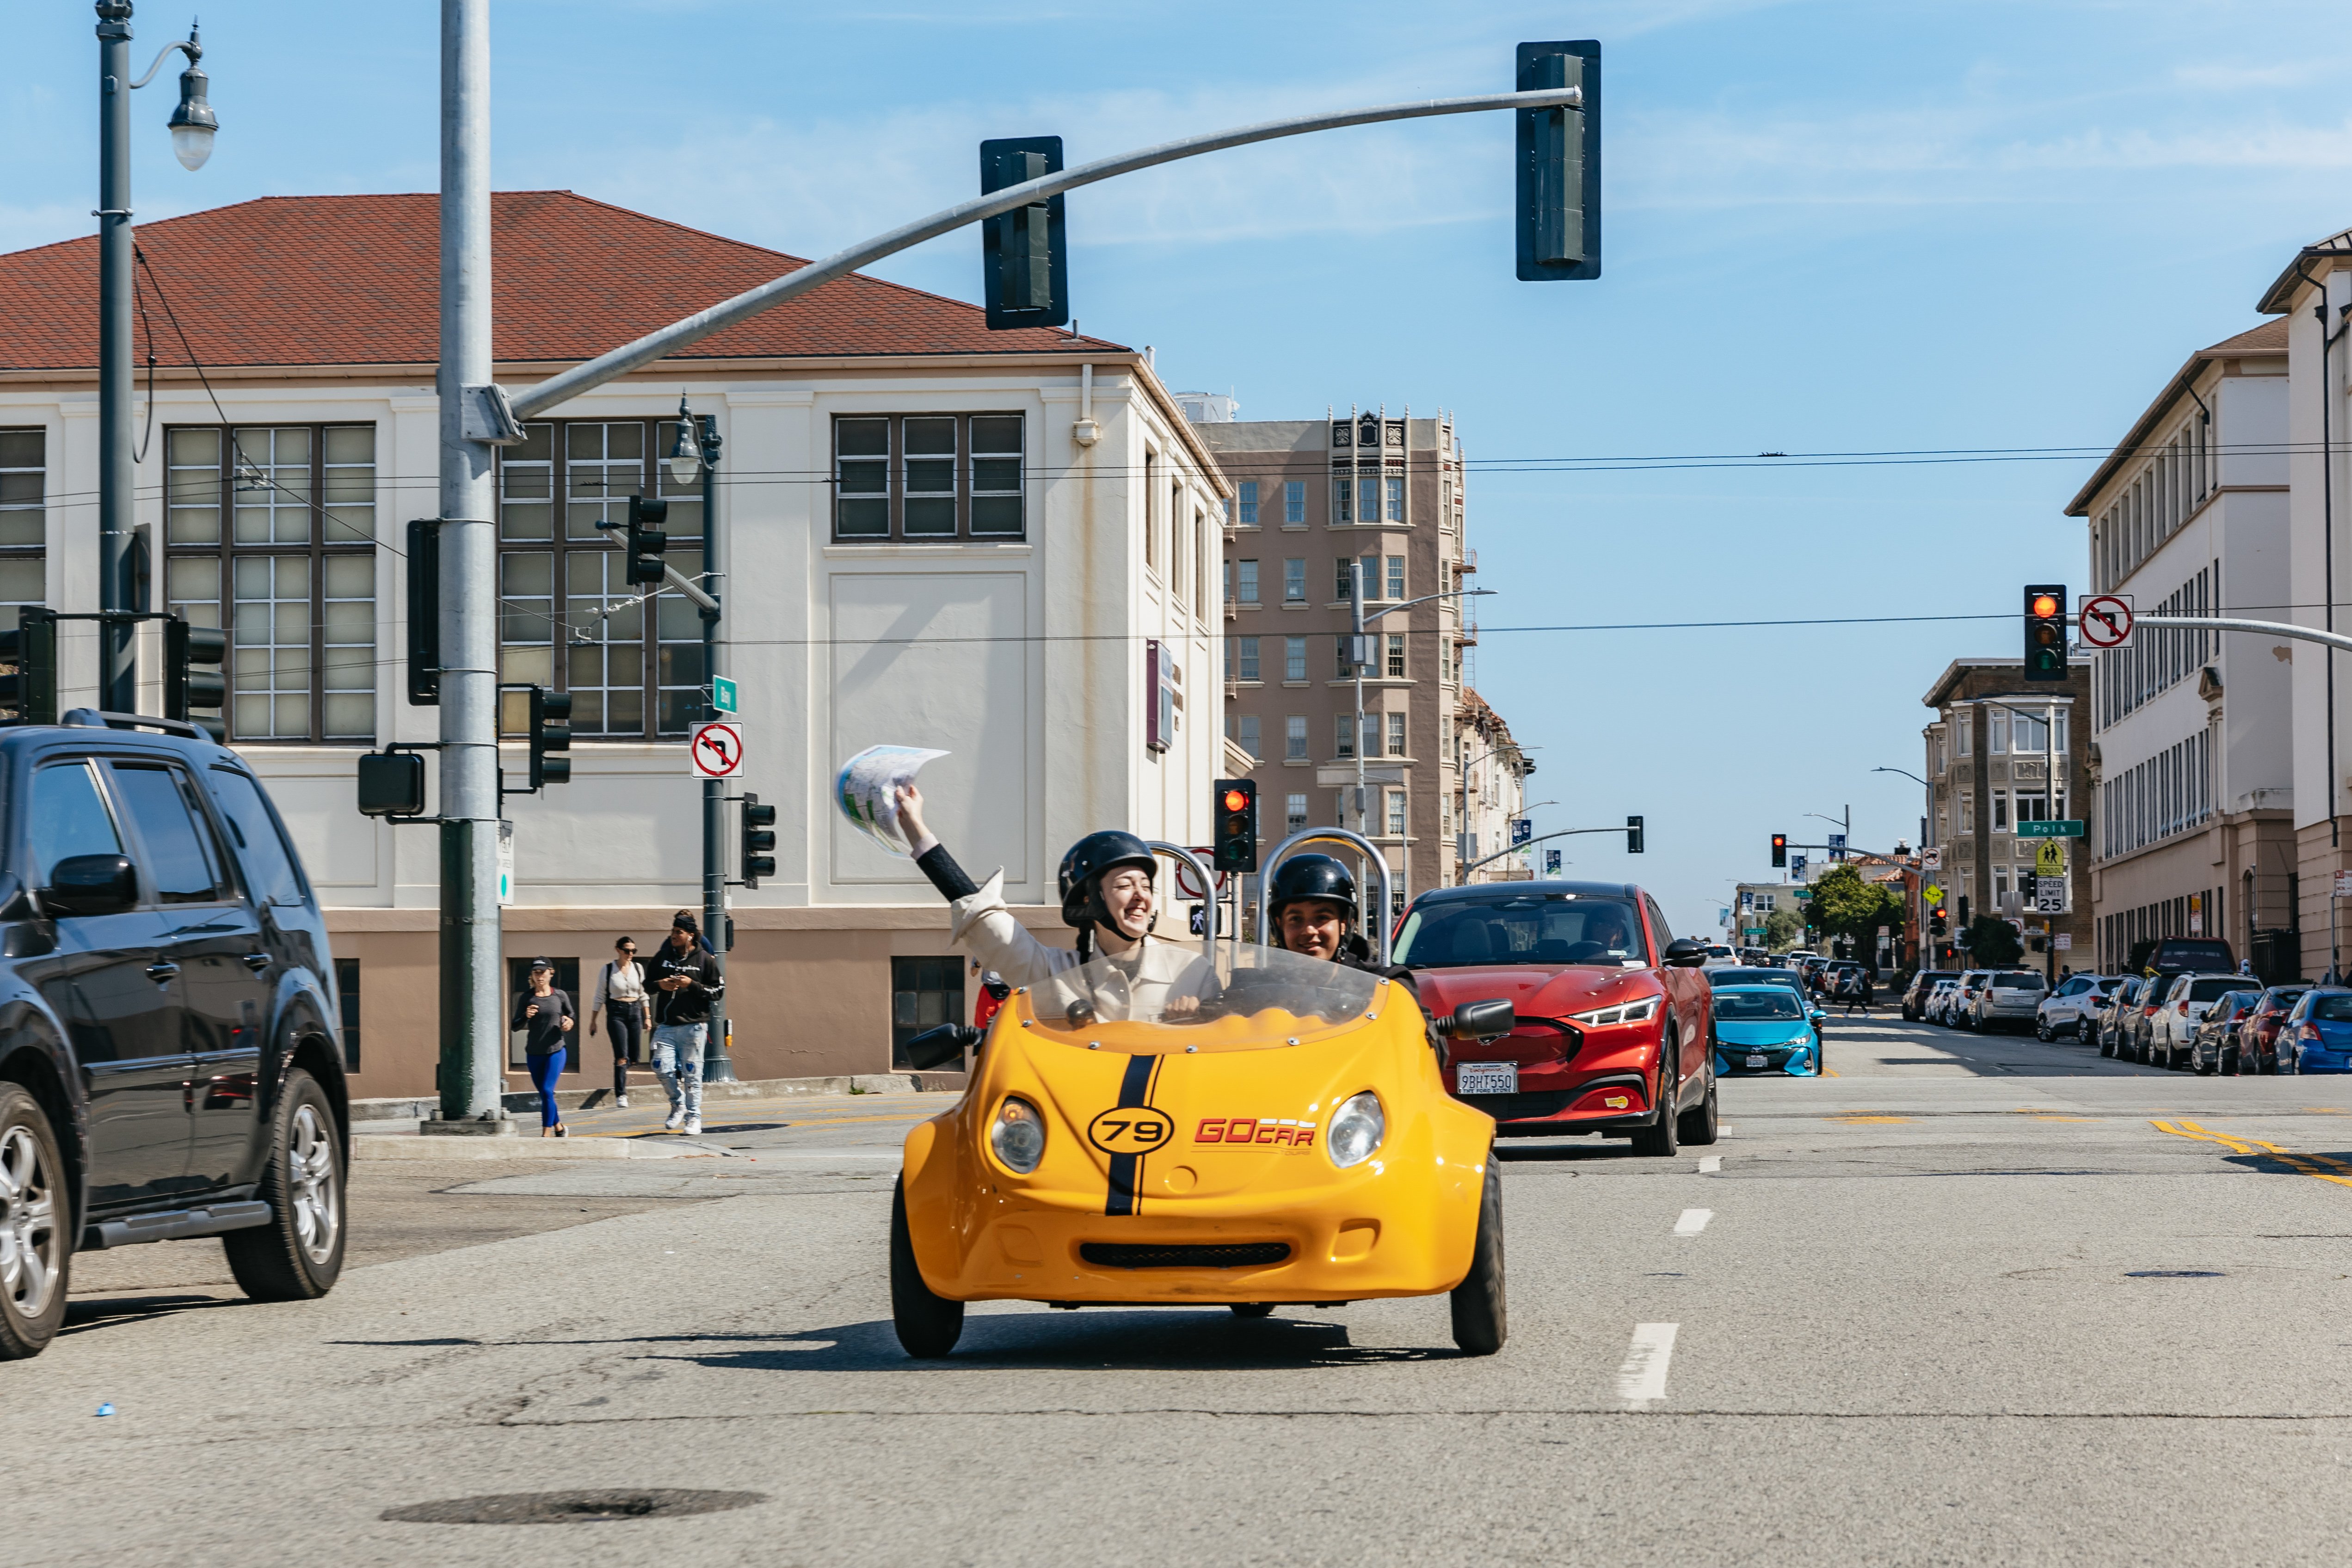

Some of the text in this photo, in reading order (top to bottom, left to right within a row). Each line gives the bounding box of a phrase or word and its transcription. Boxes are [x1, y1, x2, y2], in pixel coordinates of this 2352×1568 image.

[720, 686, 731, 708] Bay
[2039, 898, 2062, 911] 25
[1462, 1075, 1511, 1088] 9BHT550
[1102, 1121, 1164, 1142] 79
